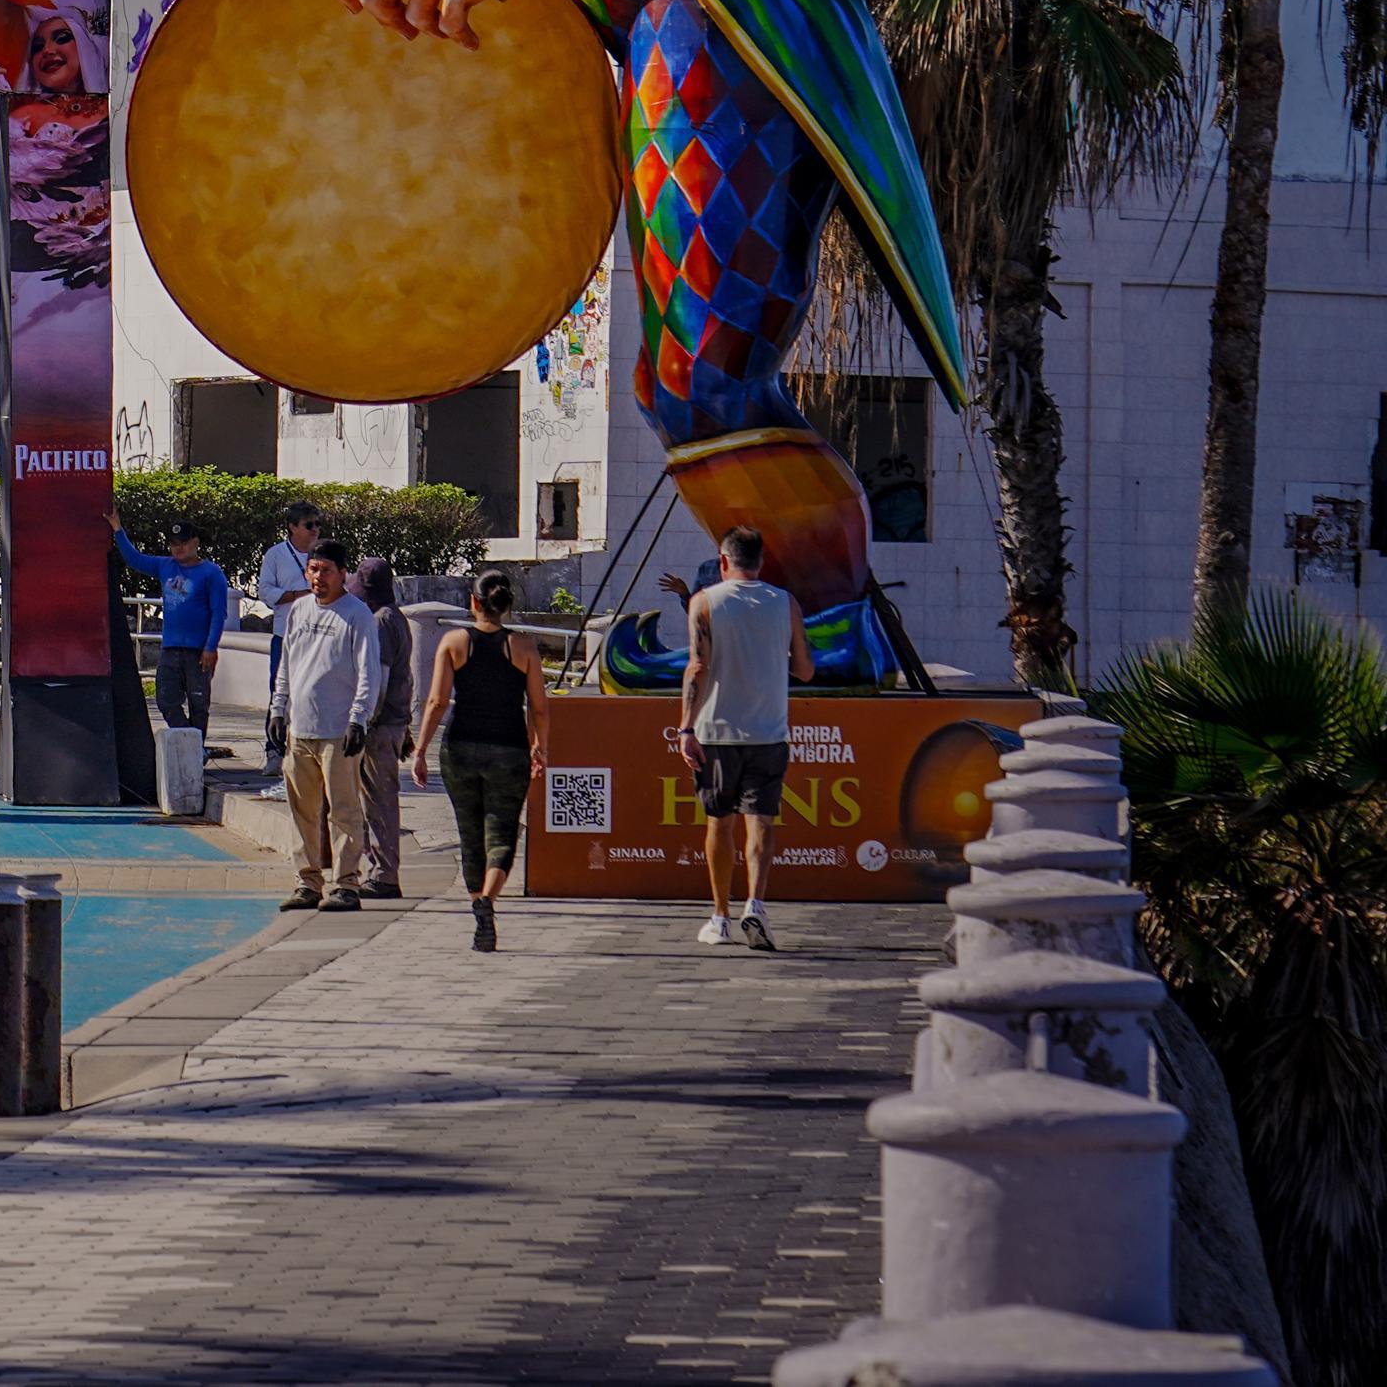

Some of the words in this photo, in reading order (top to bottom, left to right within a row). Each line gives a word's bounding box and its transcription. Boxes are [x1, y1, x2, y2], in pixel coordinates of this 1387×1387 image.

[15, 444, 108, 480] PACIFICO
[658, 775, 863, 828] HNS
[608, 847, 666, 858] SINALOA
[782, 847, 836, 857] AMAMOS
[890, 849, 938, 860] CULTURA
